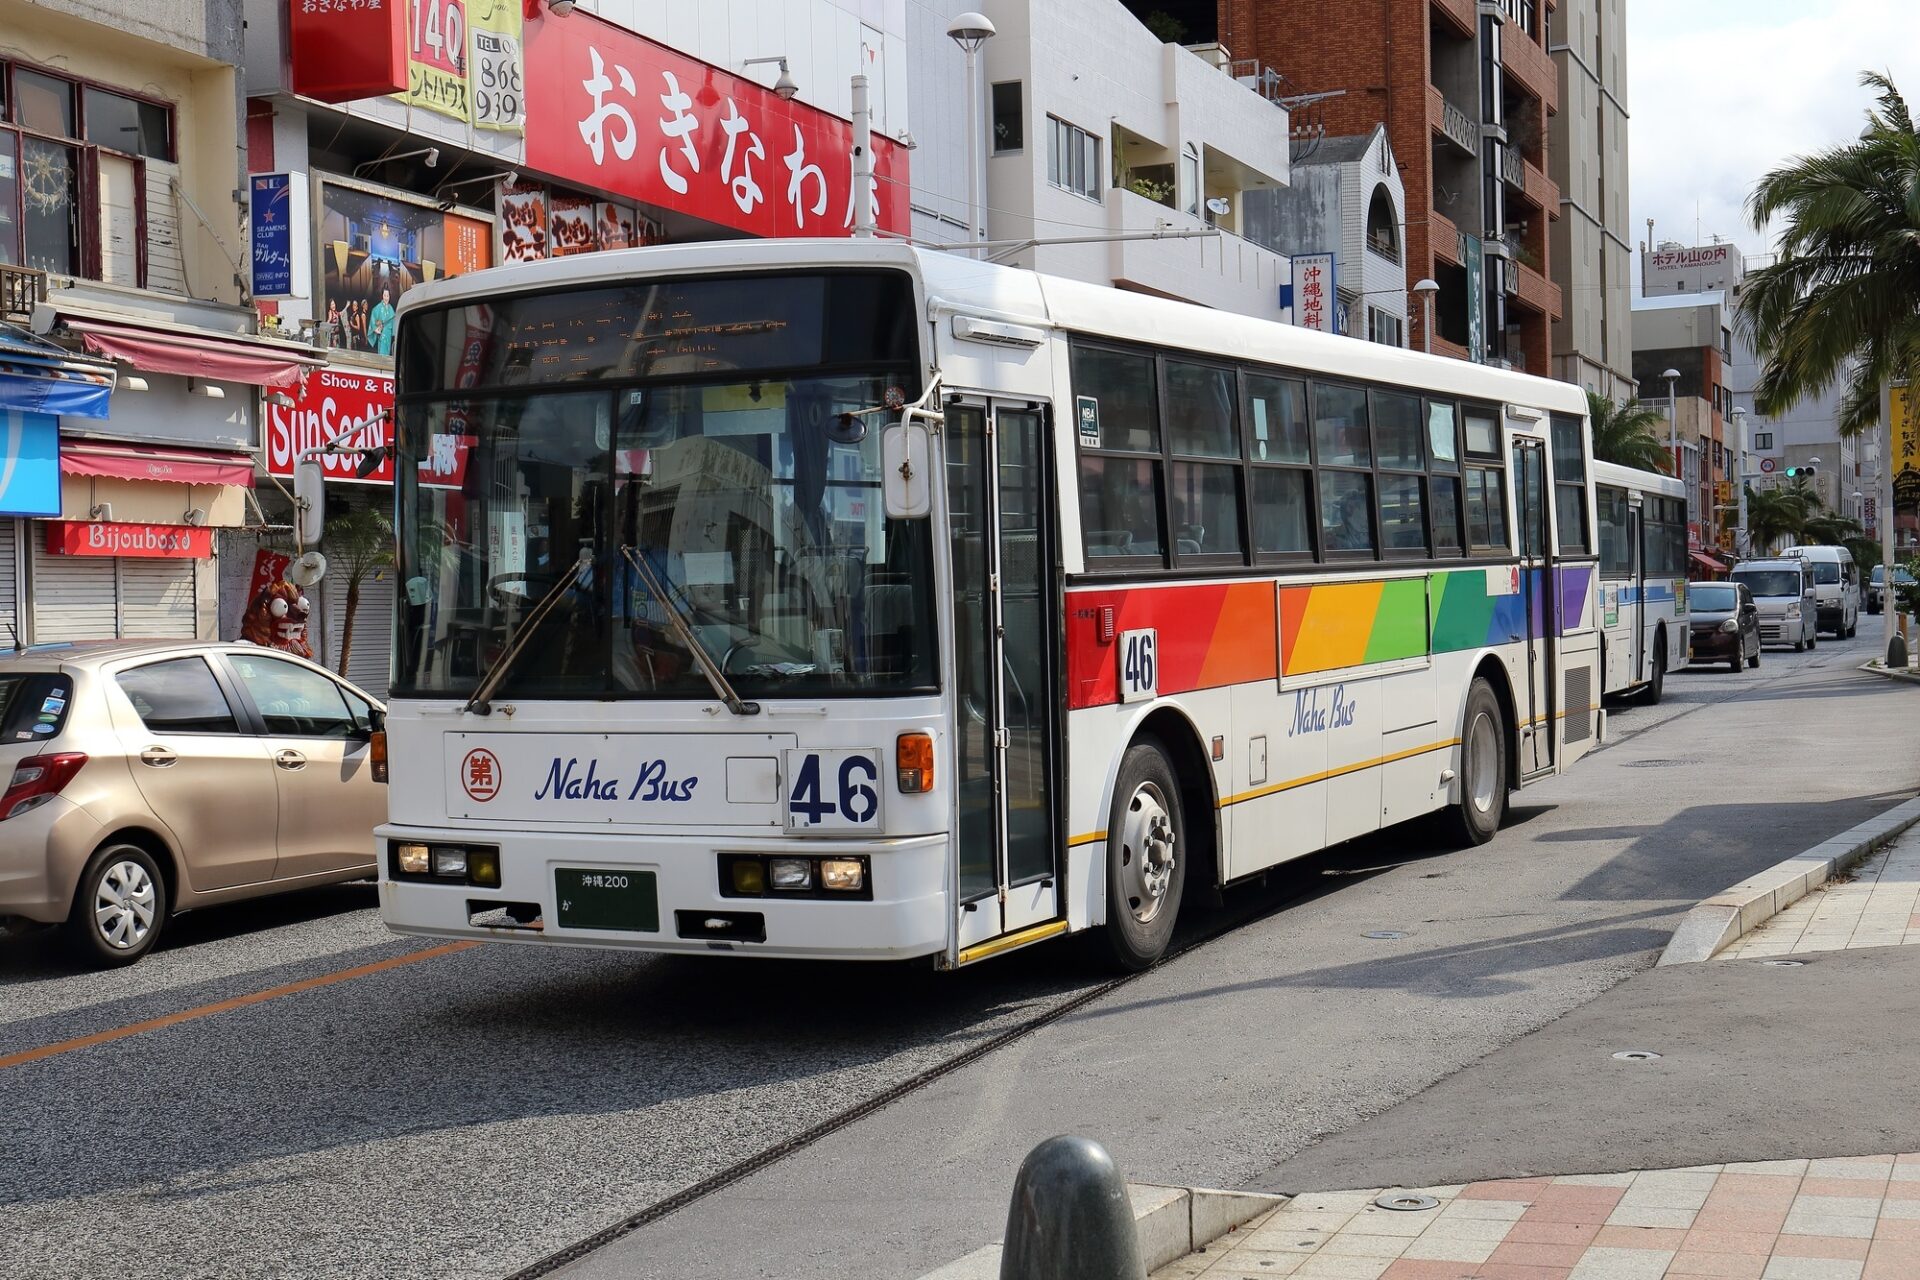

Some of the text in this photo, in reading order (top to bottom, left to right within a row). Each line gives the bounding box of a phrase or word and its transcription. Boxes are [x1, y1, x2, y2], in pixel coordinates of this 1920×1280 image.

[477, 35, 496, 51] TEL
[257, 231, 274, 239] CLUB
[1652, 247, 1727, 266] ホテル山の内
[1680, 260, 1721, 269] YAMANOUCHI
[1303, 266, 1323, 331] 沖縄地料
[321, 373, 360, 391] Show
[364, 379, 379, 393] &
[1125, 634, 1154, 693] 46
[1288, 683, 1356, 738] Naha Bus
[534, 757, 699, 802] Naha Bus
[789, 754, 878, 824] 46
[561, 899, 572, 912] か
